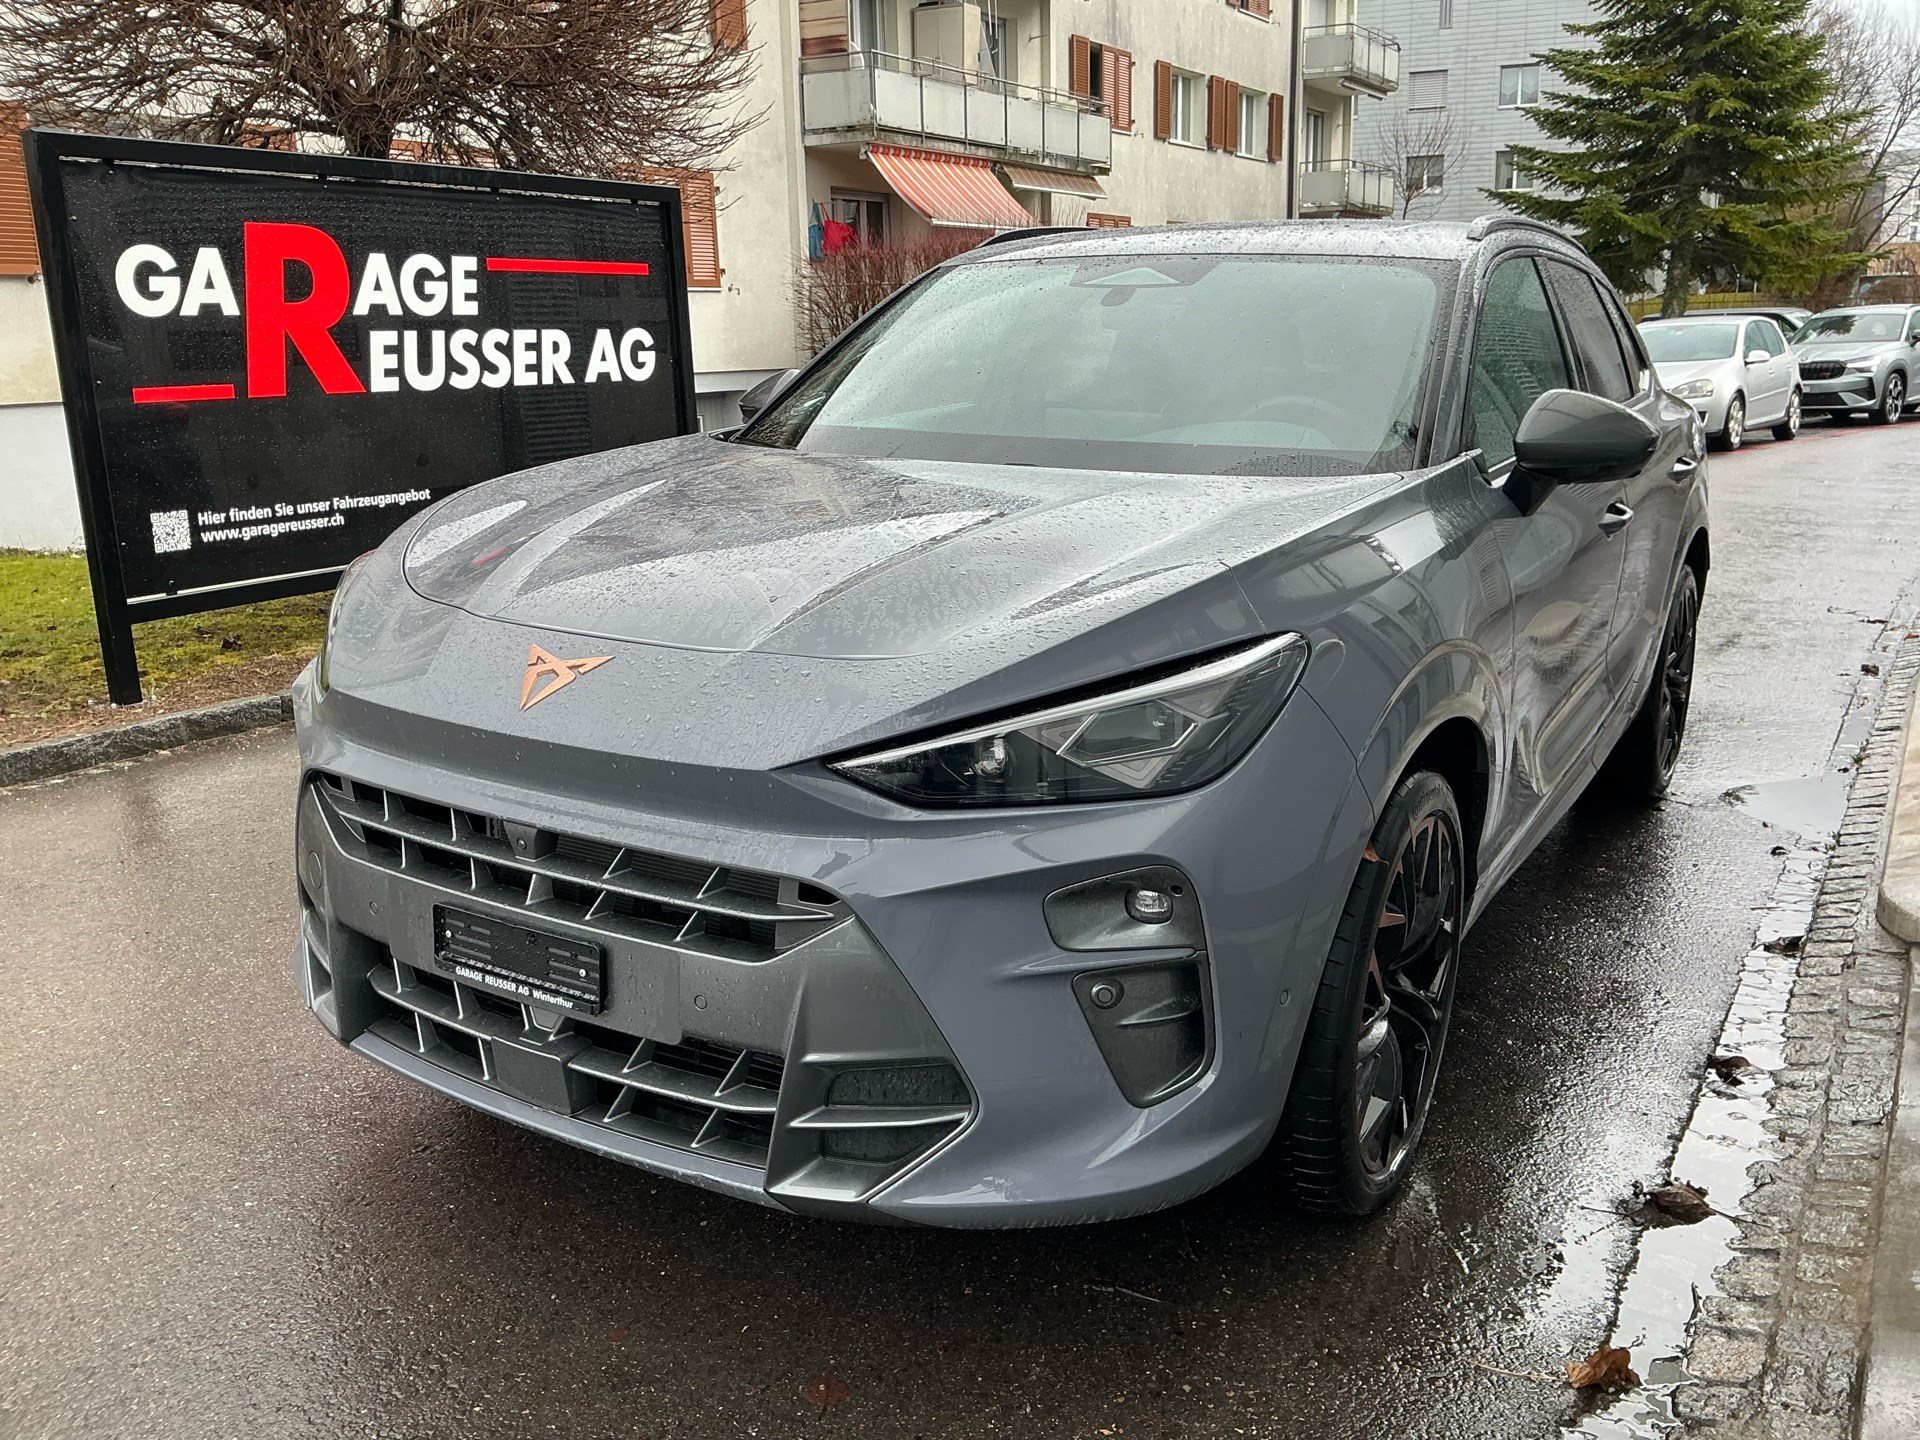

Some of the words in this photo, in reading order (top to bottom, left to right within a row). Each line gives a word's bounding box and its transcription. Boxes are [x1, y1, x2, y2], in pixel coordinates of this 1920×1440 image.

[114, 222, 479, 398] GARAGE
[585, 327, 656, 384] AG
[197, 510, 227, 527] Hier
[228, 505, 273, 523] finden
[274, 502, 295, 518] Sie
[296, 500, 331, 515] unser
[332, 488, 432, 511] Fahrzeugangebot
[200, 512, 345, 543] www.garagereusser.ch
[455, 965, 483, 983] GARAGE
[484, 974, 517, 993] REUSSER
[517, 984, 530, 997] AG
[532, 989, 574, 1009] Winterthur
